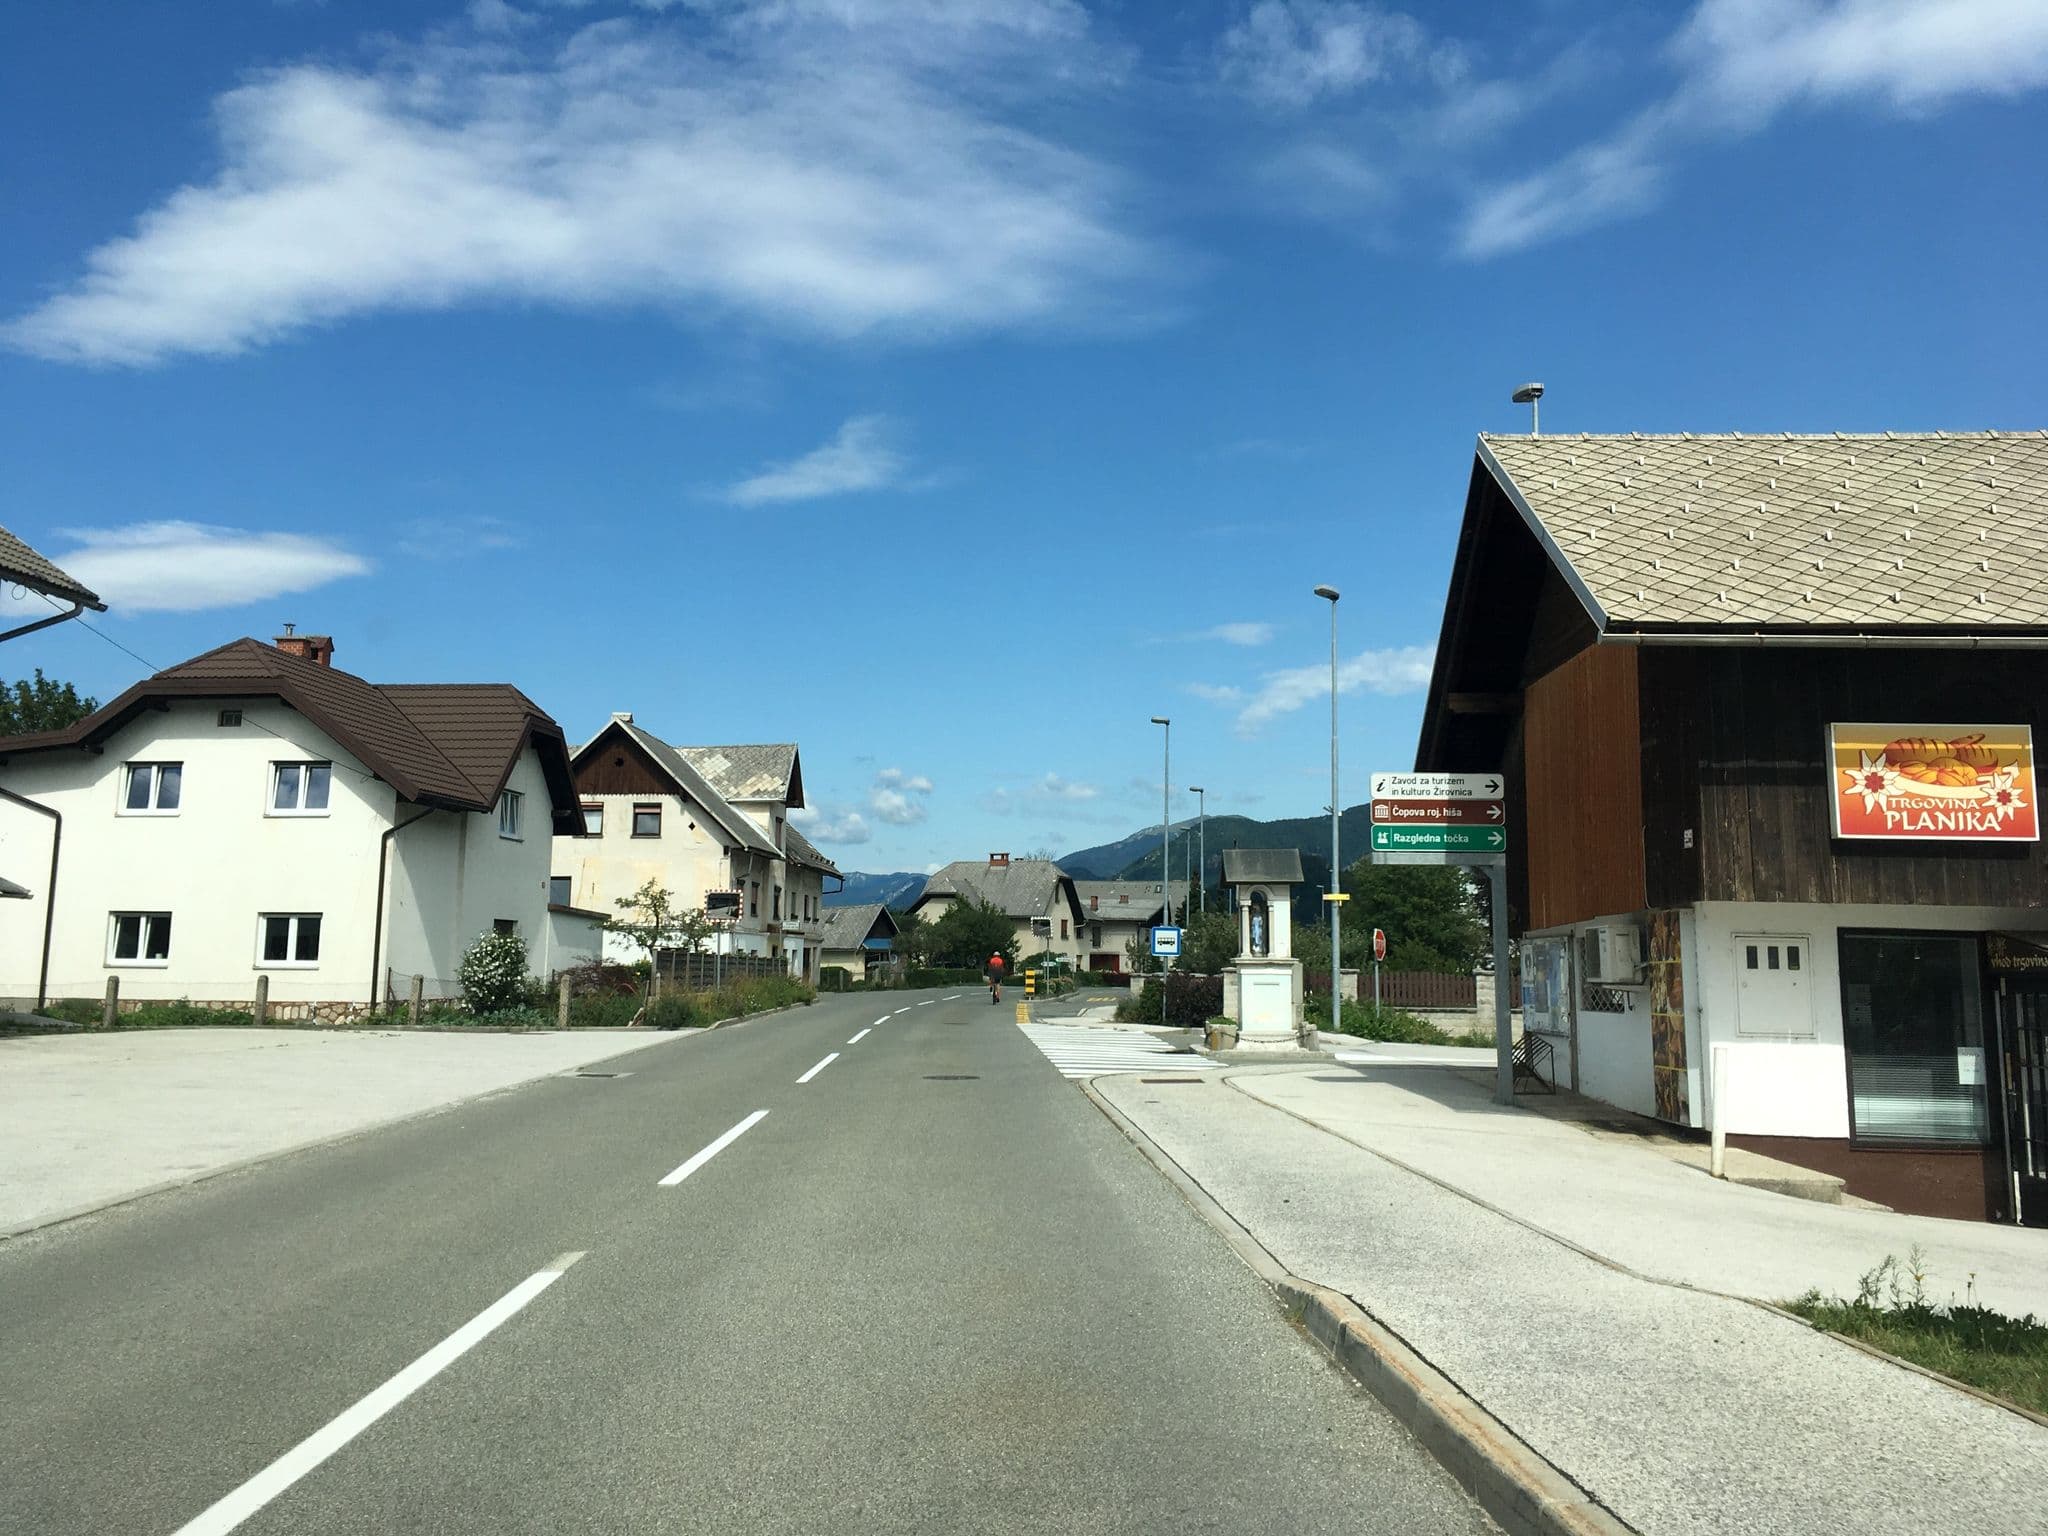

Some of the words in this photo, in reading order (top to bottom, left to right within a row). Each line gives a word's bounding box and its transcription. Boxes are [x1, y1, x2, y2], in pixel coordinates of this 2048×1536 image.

[1391, 776, 1417, 785] Zavod
[1432, 777, 1465, 785] turizem
[1391, 788, 1399, 796] in
[1433, 786, 1473, 796] Žirovnica
[1888, 798, 1980, 810] TRGOVINA
[1392, 804, 1425, 818] Čopova
[1427, 807, 1442, 818] roj.
[1443, 807, 1462, 817] hiša
[1885, 810, 2002, 832] PLANIKA
[1393, 833, 1441, 845] Razgledna
[1443, 833, 1469, 843] točka
